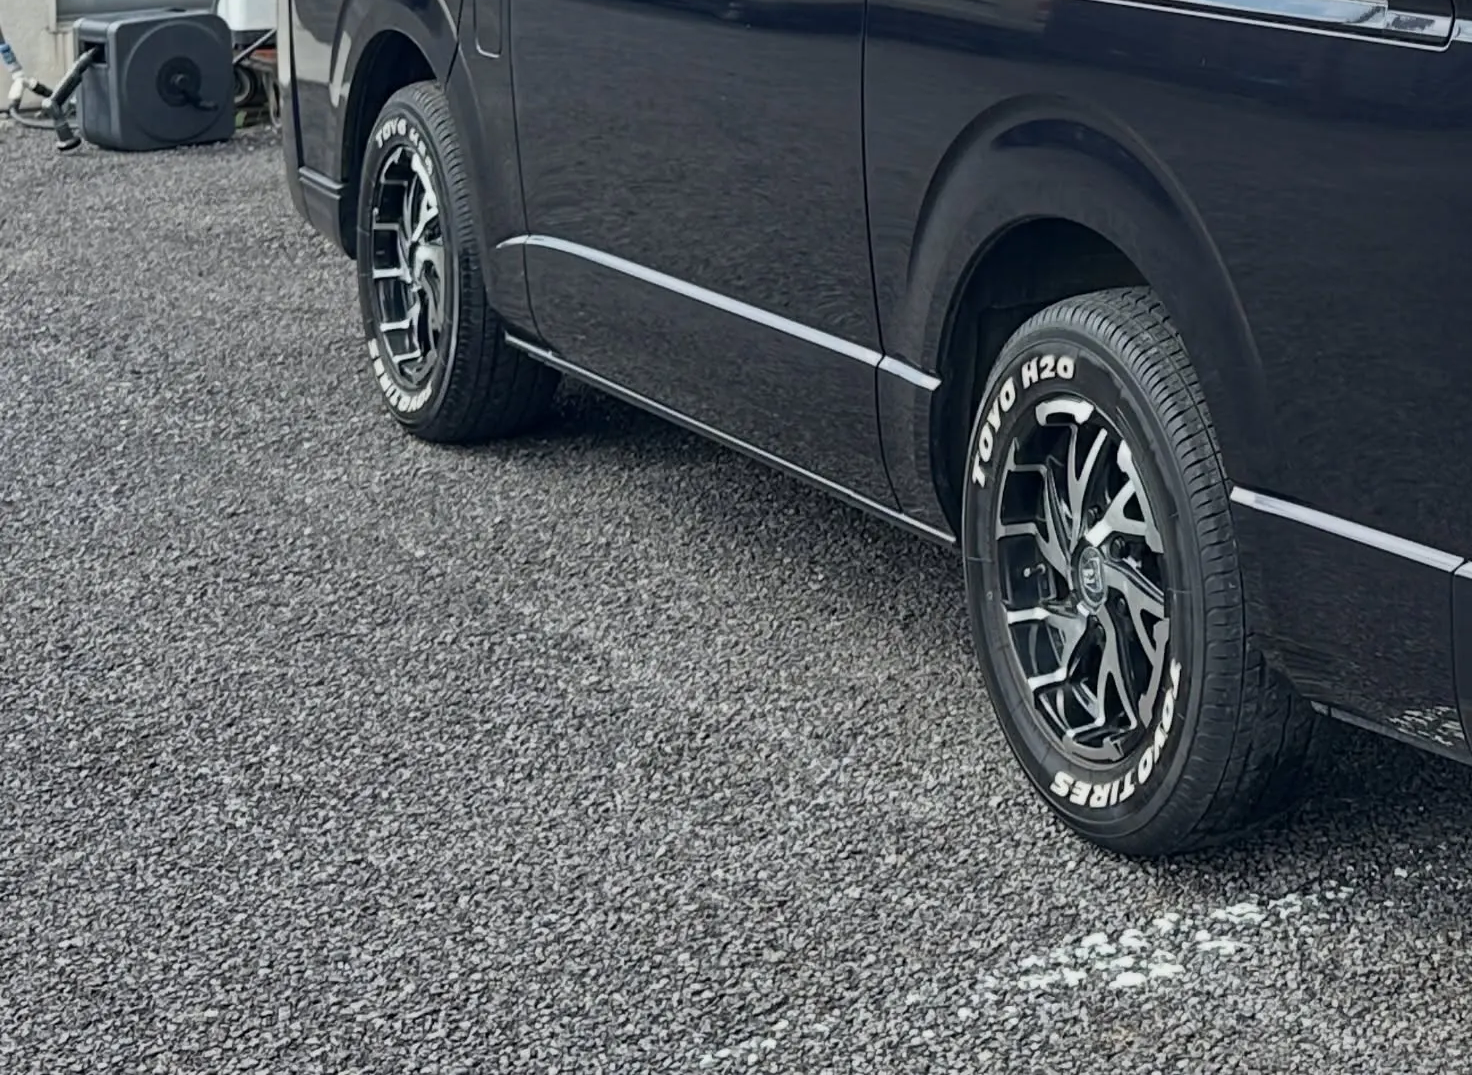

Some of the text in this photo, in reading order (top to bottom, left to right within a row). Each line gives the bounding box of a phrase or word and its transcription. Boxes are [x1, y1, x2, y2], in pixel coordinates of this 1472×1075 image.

[375, 117, 407, 148] TOYO
[972, 377, 1016, 488] TOYO
[1050, 658, 1182, 808] TOYO TIRES
